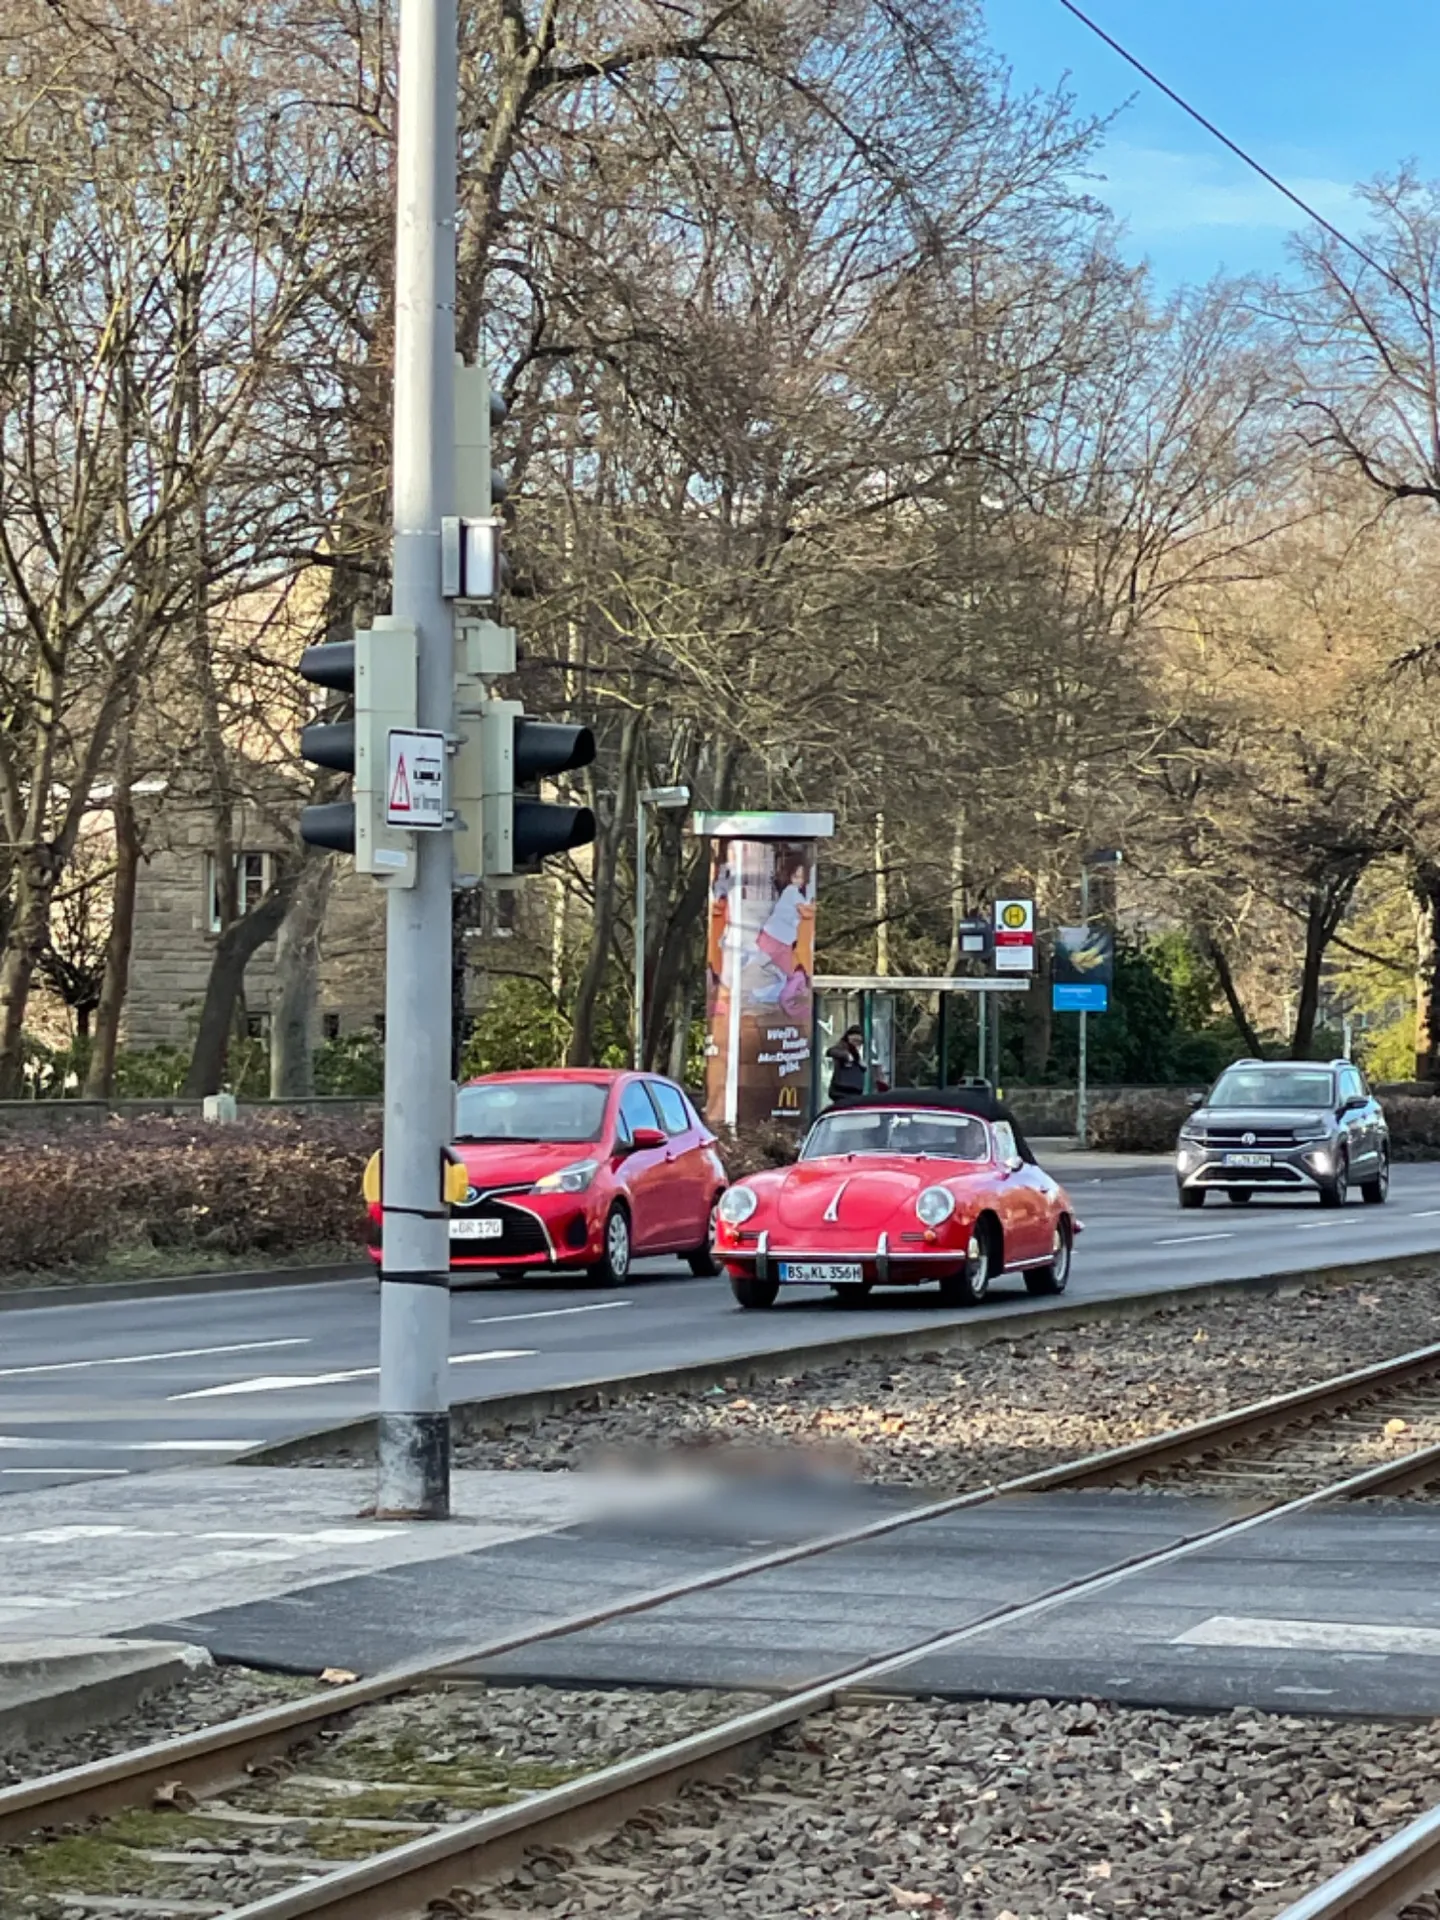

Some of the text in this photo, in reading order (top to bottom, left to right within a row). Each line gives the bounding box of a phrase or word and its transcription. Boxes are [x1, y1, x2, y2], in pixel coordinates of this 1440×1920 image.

[1008, 909, 1020, 923] H
[788, 1265, 803, 1279] BS
[810, 1265, 827, 1279] KL
